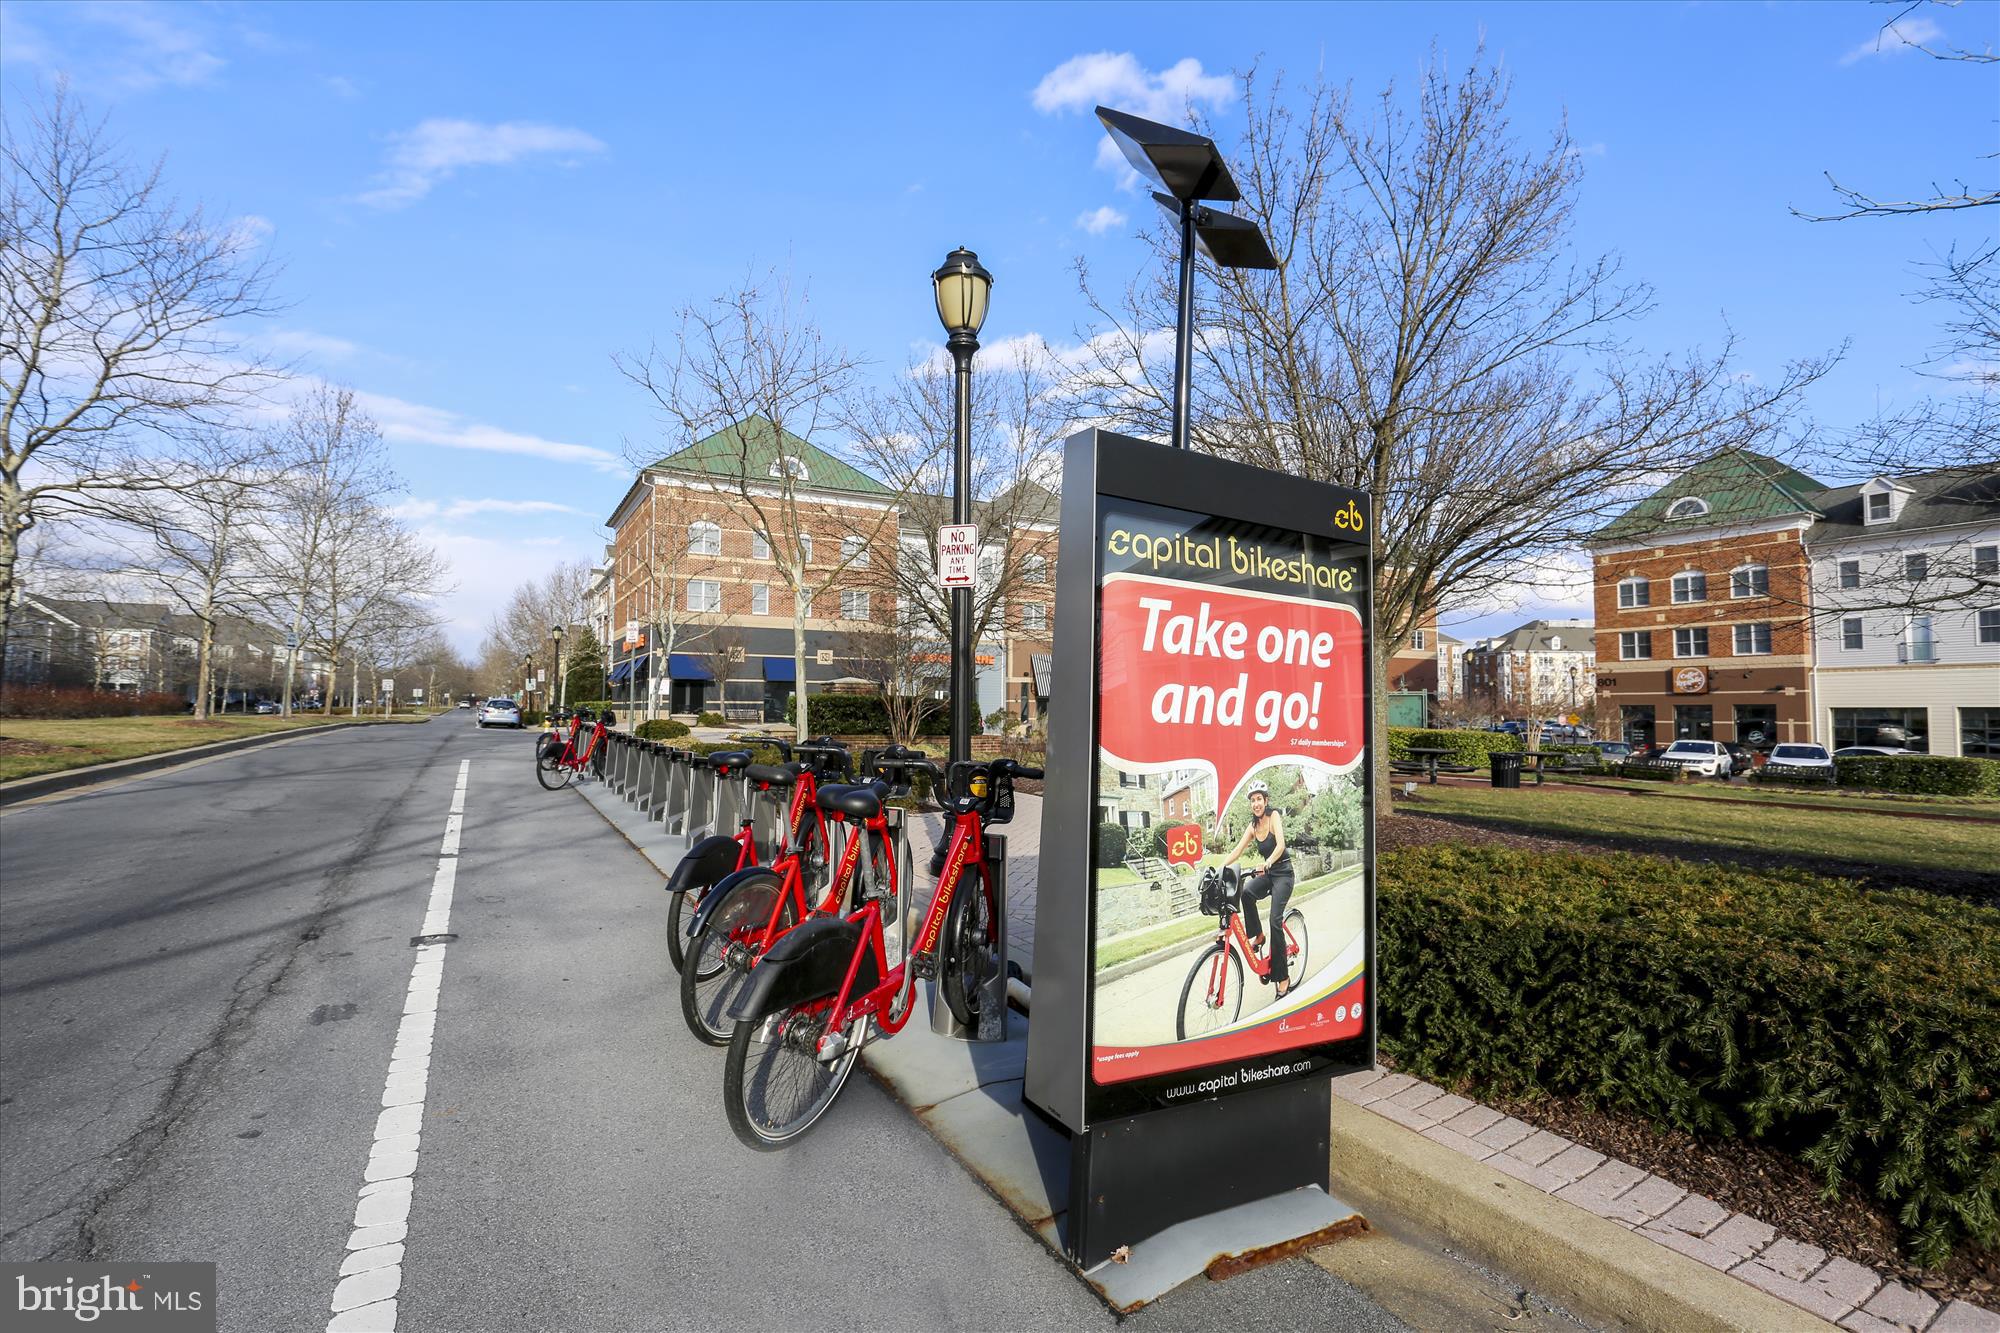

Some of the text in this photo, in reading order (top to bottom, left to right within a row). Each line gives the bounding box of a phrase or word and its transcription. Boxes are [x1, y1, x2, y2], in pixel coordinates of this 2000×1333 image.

[941, 543, 975, 556] PARKING
[951, 531, 965, 543] NO
[949, 565, 967, 574] TIME
[950, 556, 965, 565] ANY
[1108, 529, 1220, 569] capital
[1227, 535, 1353, 592] bikeshare
[1138, 597, 1334, 668] Take one
[1151, 672, 1323, 742] and go!
[939, 841, 969, 904] bikeshare
